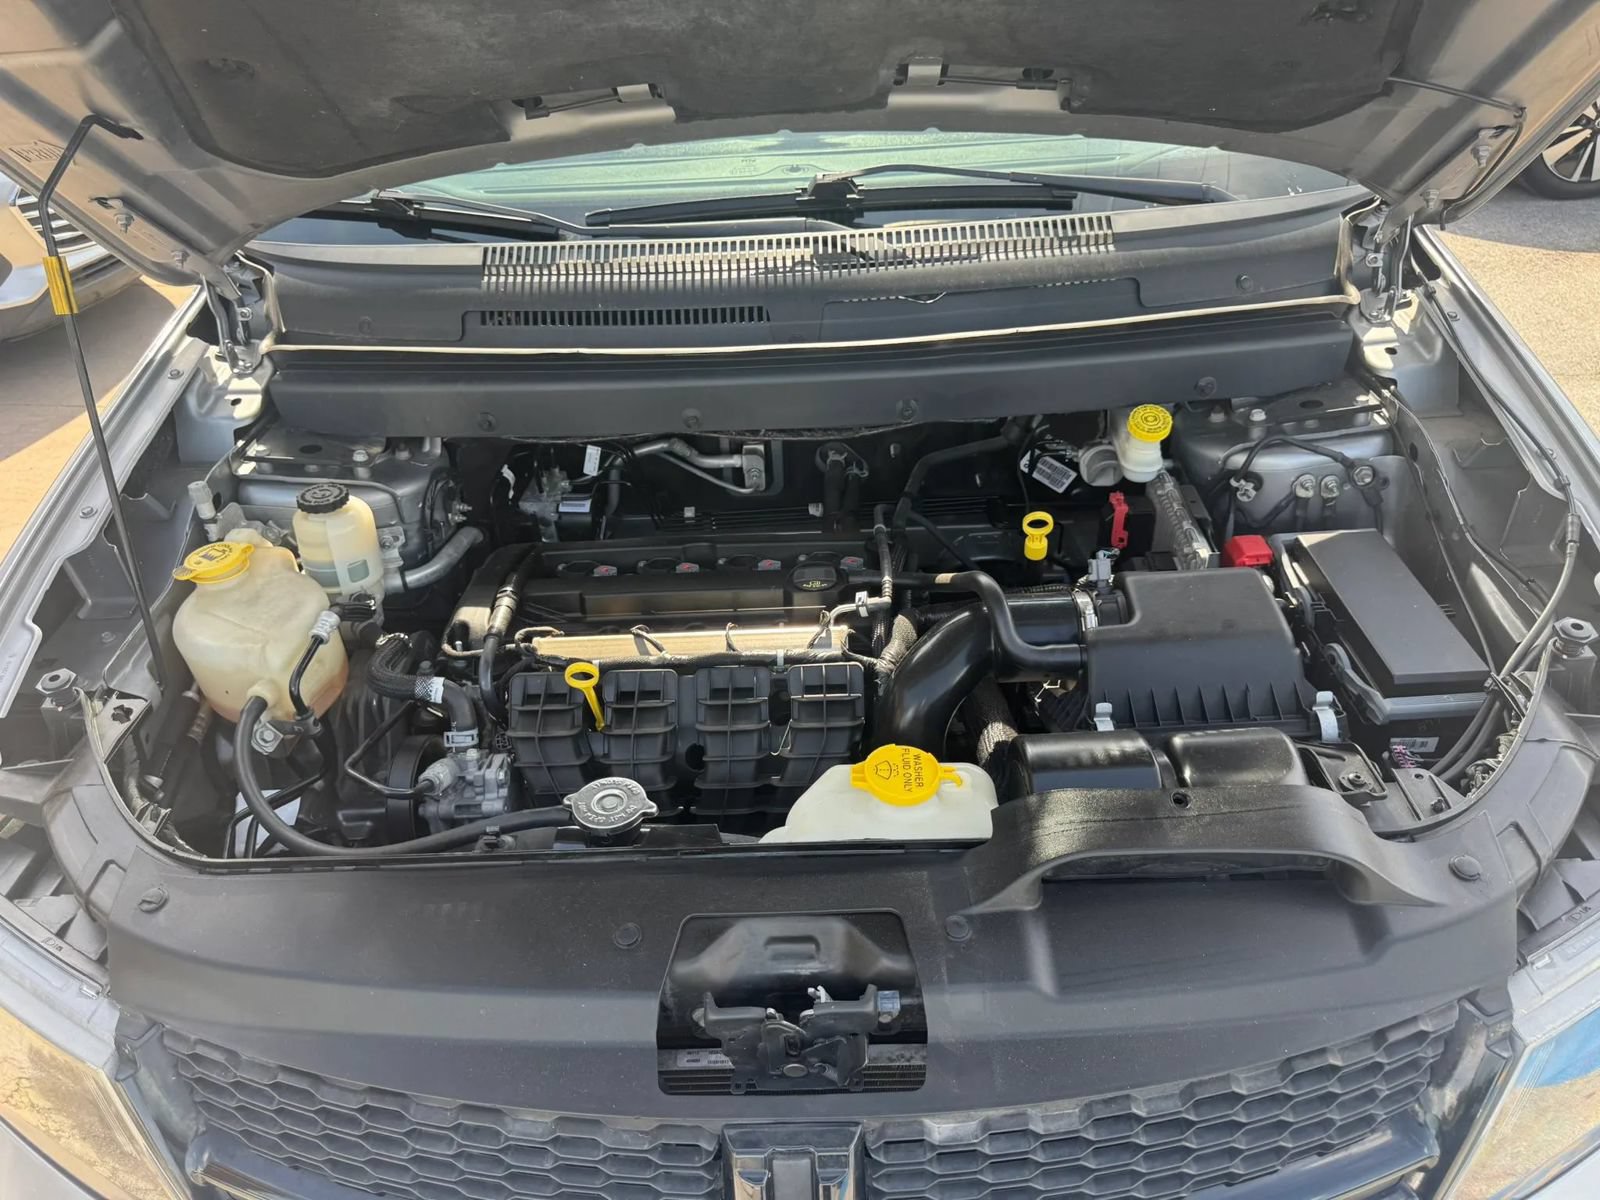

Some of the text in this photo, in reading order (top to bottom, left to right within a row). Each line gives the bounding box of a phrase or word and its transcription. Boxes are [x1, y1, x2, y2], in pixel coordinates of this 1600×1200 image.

[902, 748, 912, 792] FLUID ONLY
[913, 753, 924, 788] WASHER
